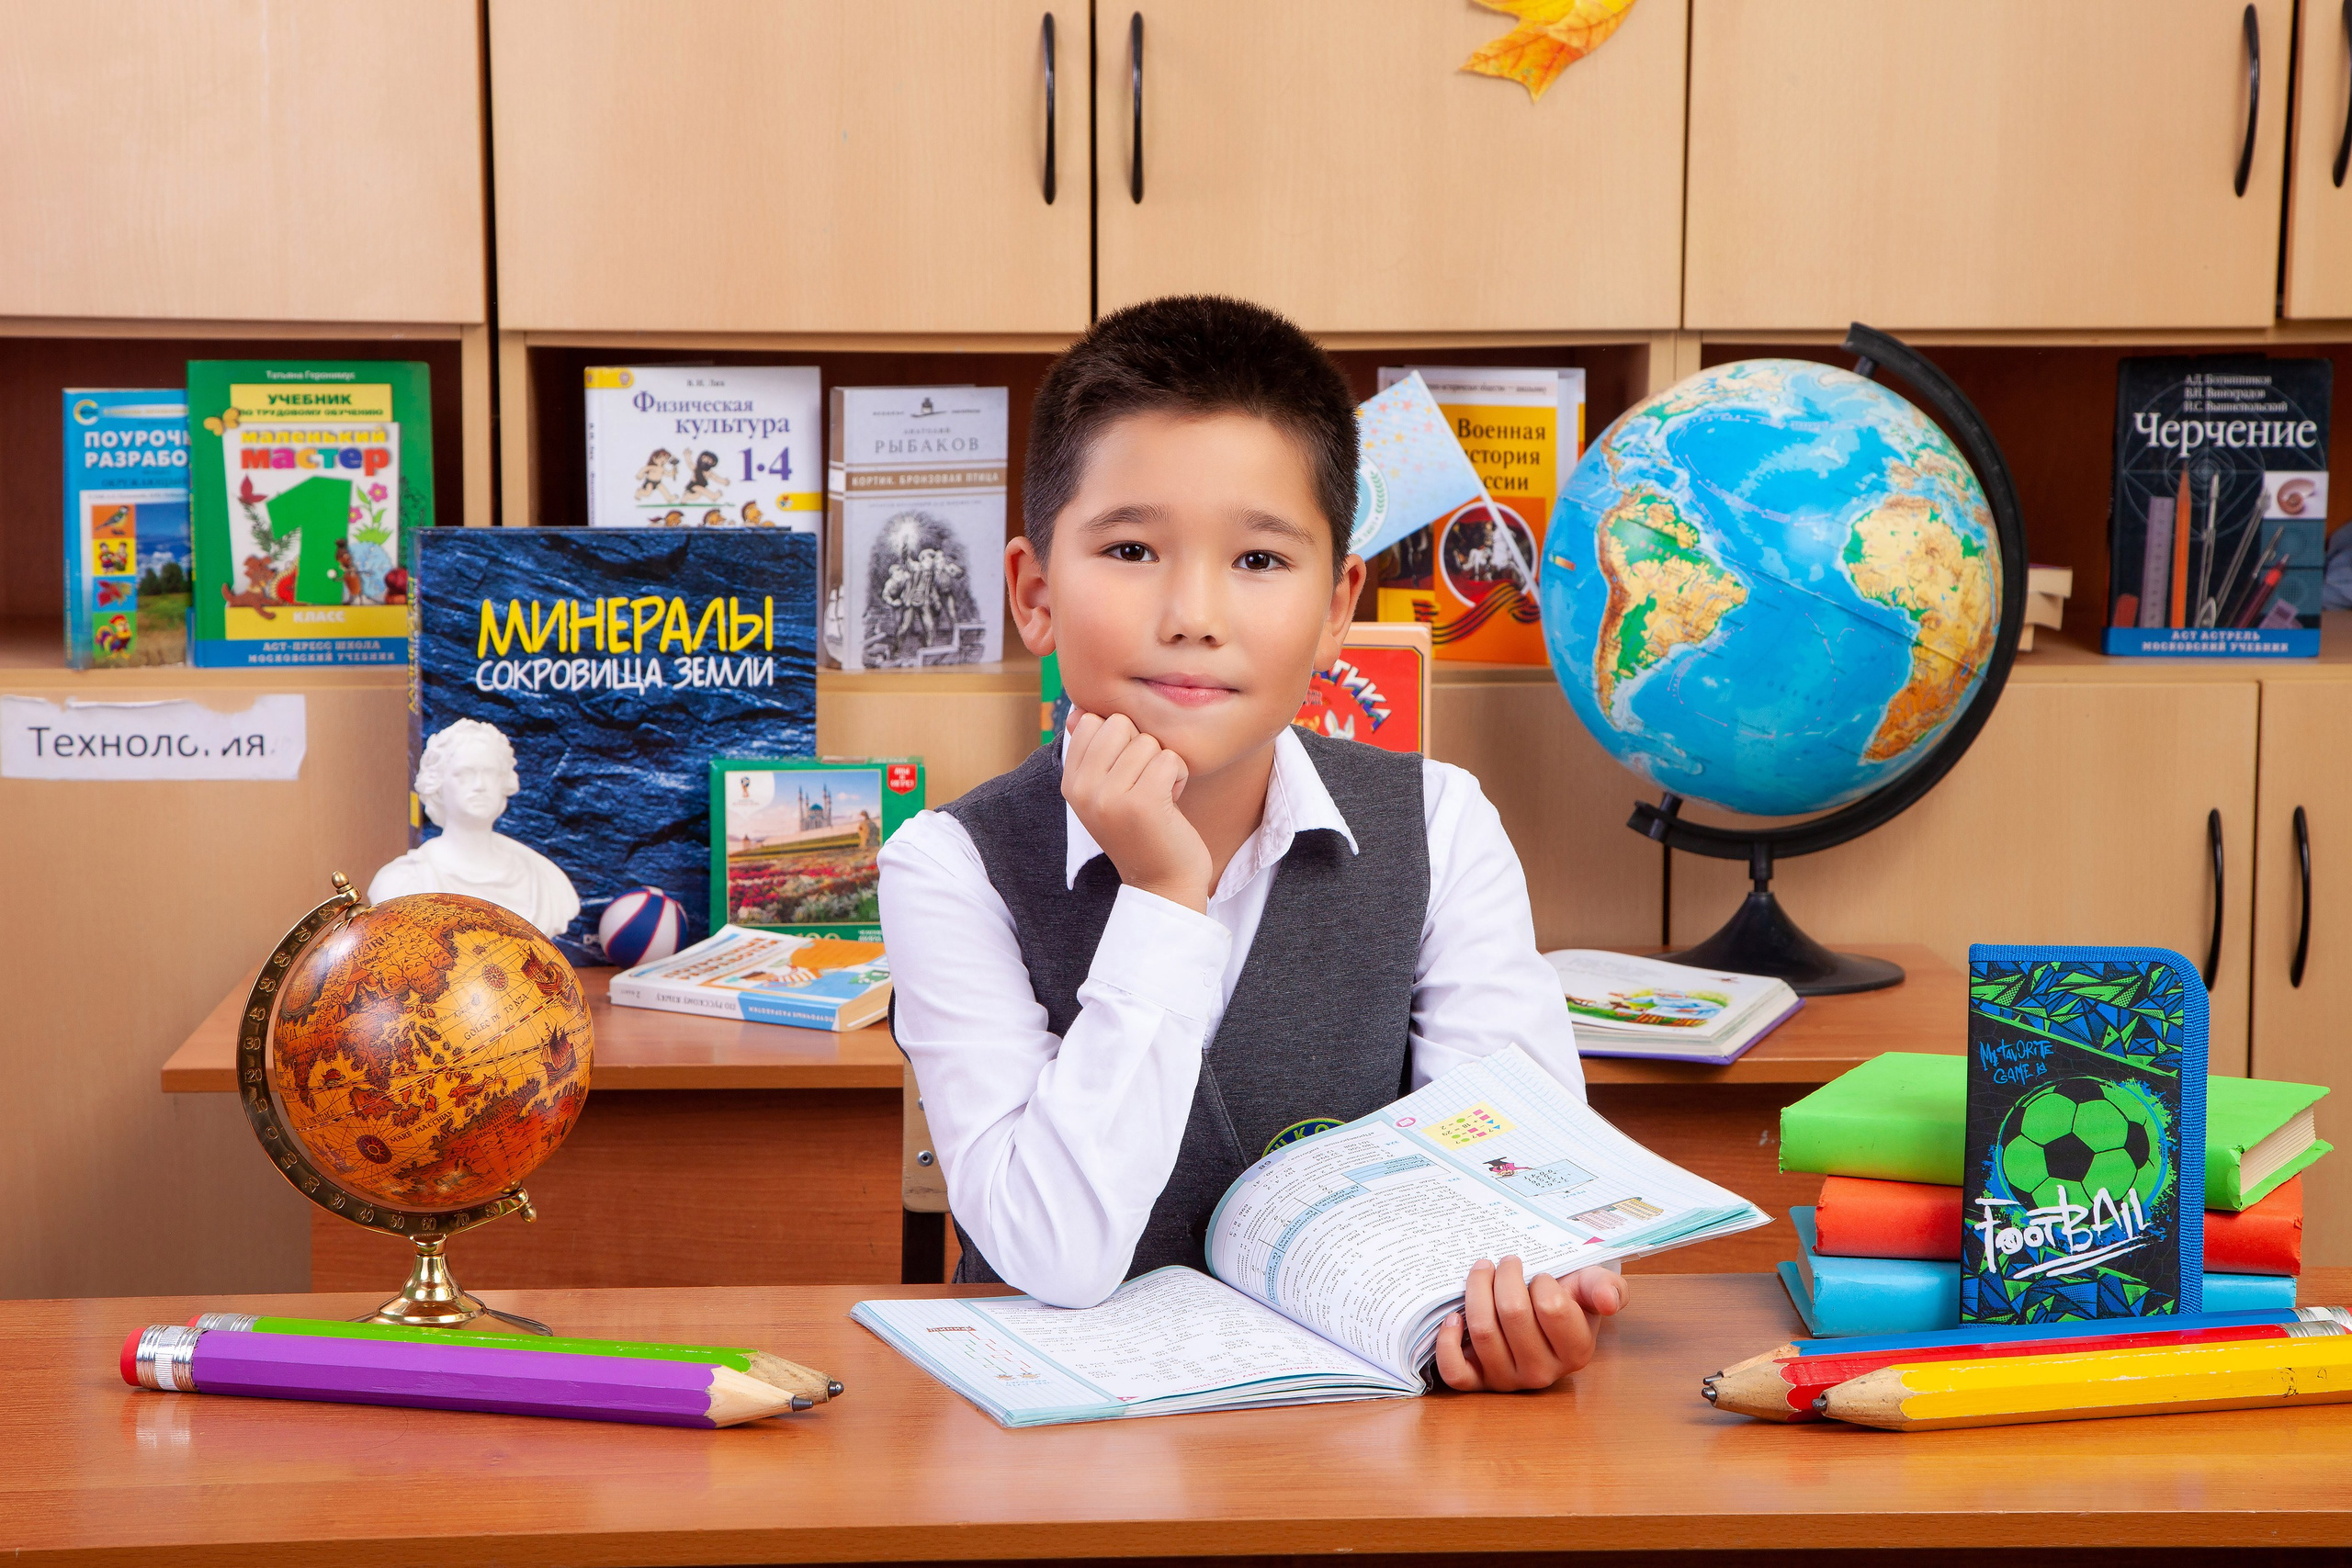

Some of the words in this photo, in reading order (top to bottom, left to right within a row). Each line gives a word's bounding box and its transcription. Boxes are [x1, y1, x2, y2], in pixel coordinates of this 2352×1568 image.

[267, 393, 353, 405] УЧЕБНИК
[632, 390, 753, 412] Физическая
[2205, 388, 2266, 400] Виноградов
[256, 409, 321, 417] ТРУДОВОМУ
[241, 426, 387, 444] маленький
[674, 416, 791, 440] культура
[1457, 418, 1545, 440] Военная
[2134, 412, 2317, 458] Черчение
[875, 437, 979, 454] РЫБАКОВ
[85, 448, 188, 468] РАЗРАБО
[241, 447, 390, 477] мастер
[1464, 449, 1541, 469] стория
[899, 473, 962, 485] БРОНЗОВАЯ
[966, 472, 1000, 483] ПТИЦА
[1482, 476, 1530, 491] ссии
[266, 476, 353, 605] 1
[293, 610, 346, 624] КЛАСС
[478, 595, 774, 659] МИНЕРАЛЫ
[2172, 630, 2198, 641] АСТ
[2200, 630, 2260, 641] АСТРЕЛЬ
[263, 641, 333, 652] АСТ-ПРЕСС
[335, 640, 380, 650] ШКОЛА
[2142, 640, 2226, 652] МОСКОВСКИЙ
[2230, 642, 2289, 653] УЧЕБНИК
[248, 652, 334, 663] МОСКОВСКИЙ
[337, 652, 395, 661] УЧЕБНИК
[476, 657, 663, 695] СОКРОВИЩА
[673, 656, 775, 690] ЗЕМЛИ
[295, 926, 311, 942] 70
[249, 1006, 266, 1021] 40
[280, 1027, 299, 1043] ASIA
[243, 1036, 261, 1050] 30
[245, 1068, 263, 1083] 20
[254, 1098, 268, 1113] 10
[266, 1125, 279, 1139] 0
[390, 1131, 412, 1145] MARE
[280, 1151, 298, 1169] 10
[304, 1177, 321, 1193] 20
[331, 1194, 346, 1210] 30
[356, 1209, 375, 1223] 40
[484, 1203, 500, 1218] 80
[390, 1215, 405, 1229] 50
[421, 1217, 437, 1231] 60
